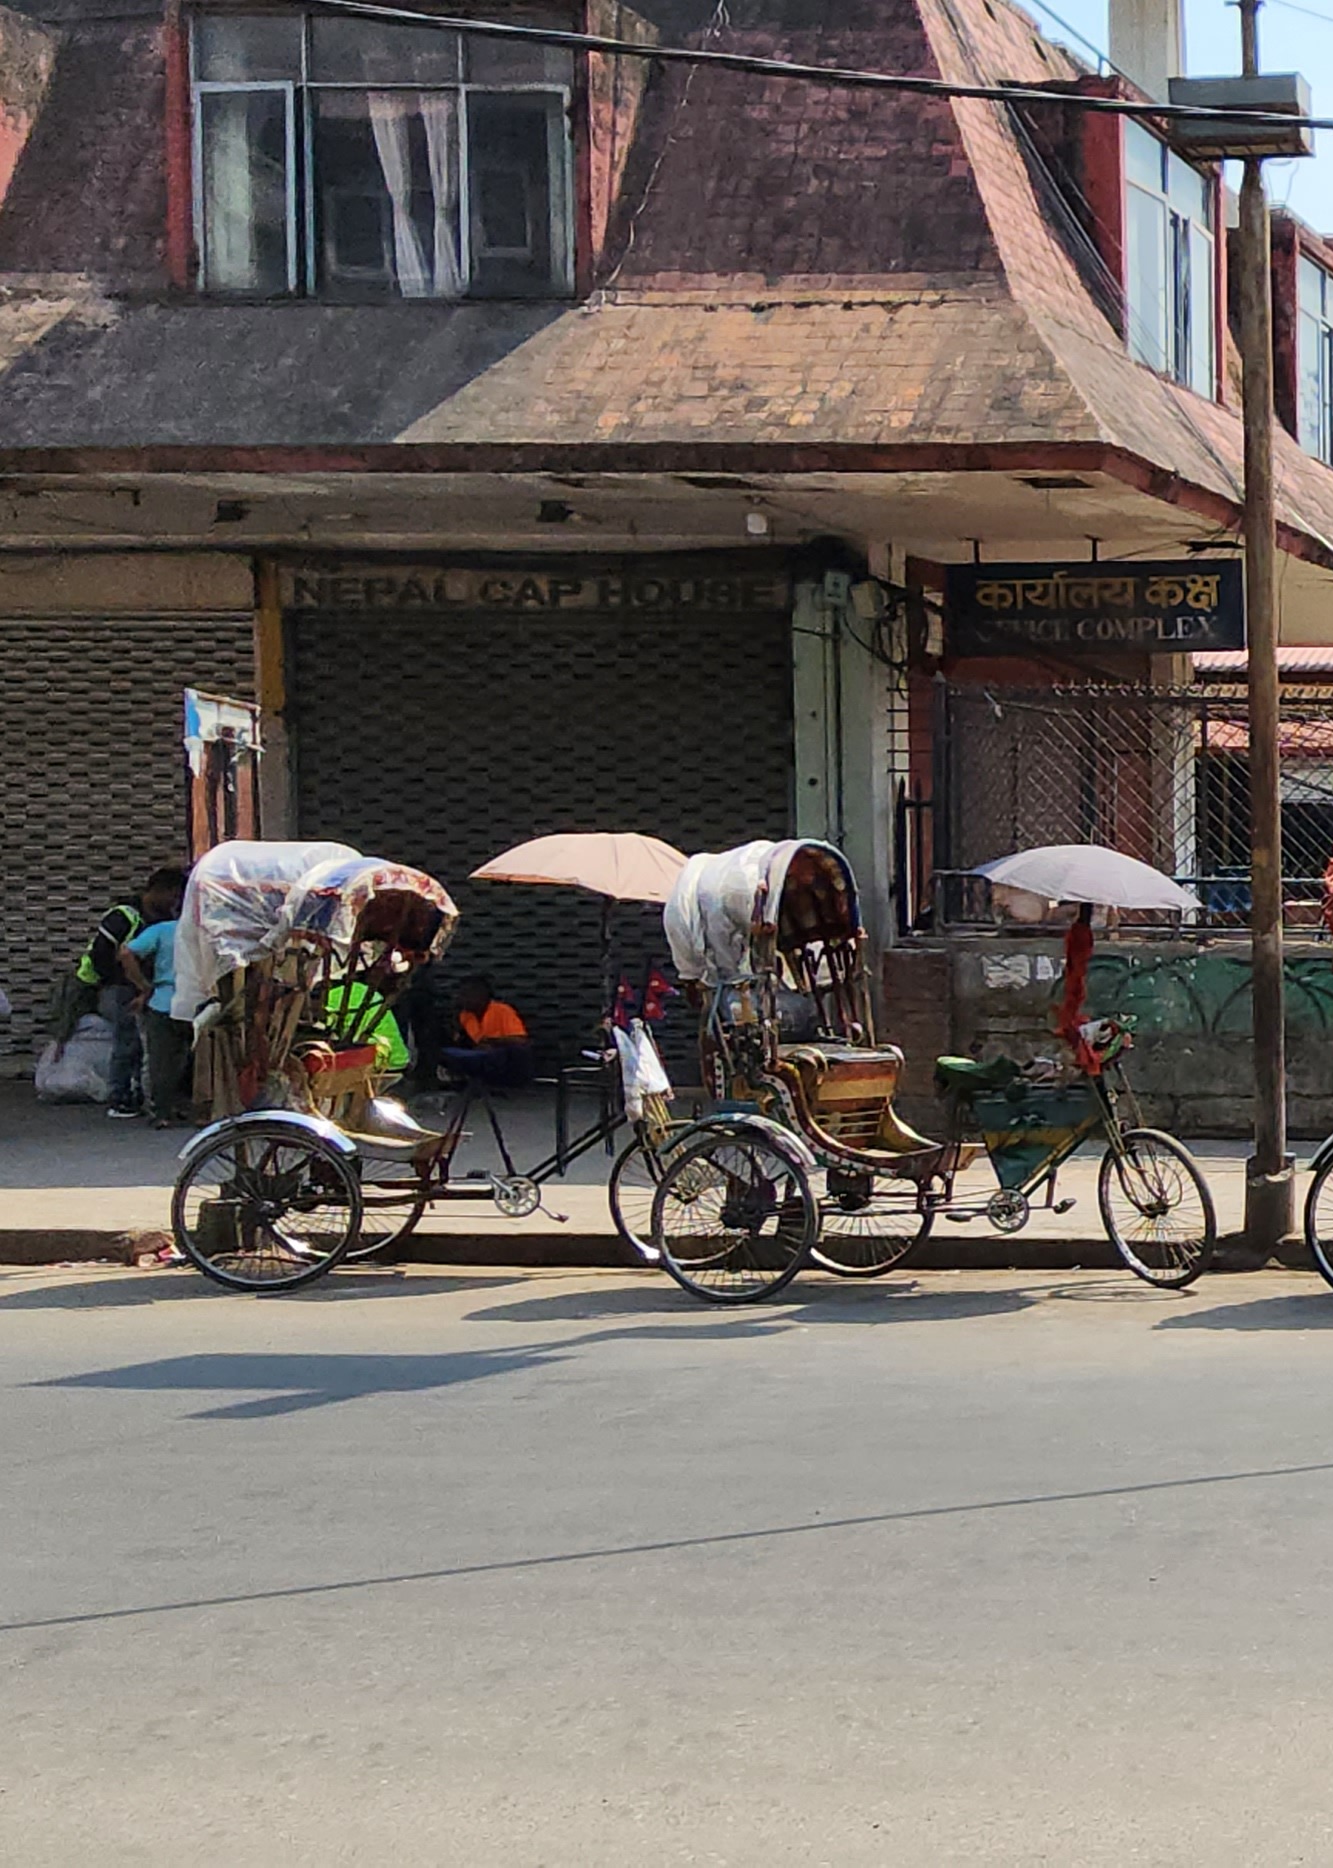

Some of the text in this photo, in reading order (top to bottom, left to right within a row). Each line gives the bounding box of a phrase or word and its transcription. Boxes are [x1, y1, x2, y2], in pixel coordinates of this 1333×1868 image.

[294, 574, 775, 607] NEPAL CAP HOUSE
[976, 571, 1221, 612] कार्यालय कक्ष
[1077, 615, 1217, 642] COMPLEX
